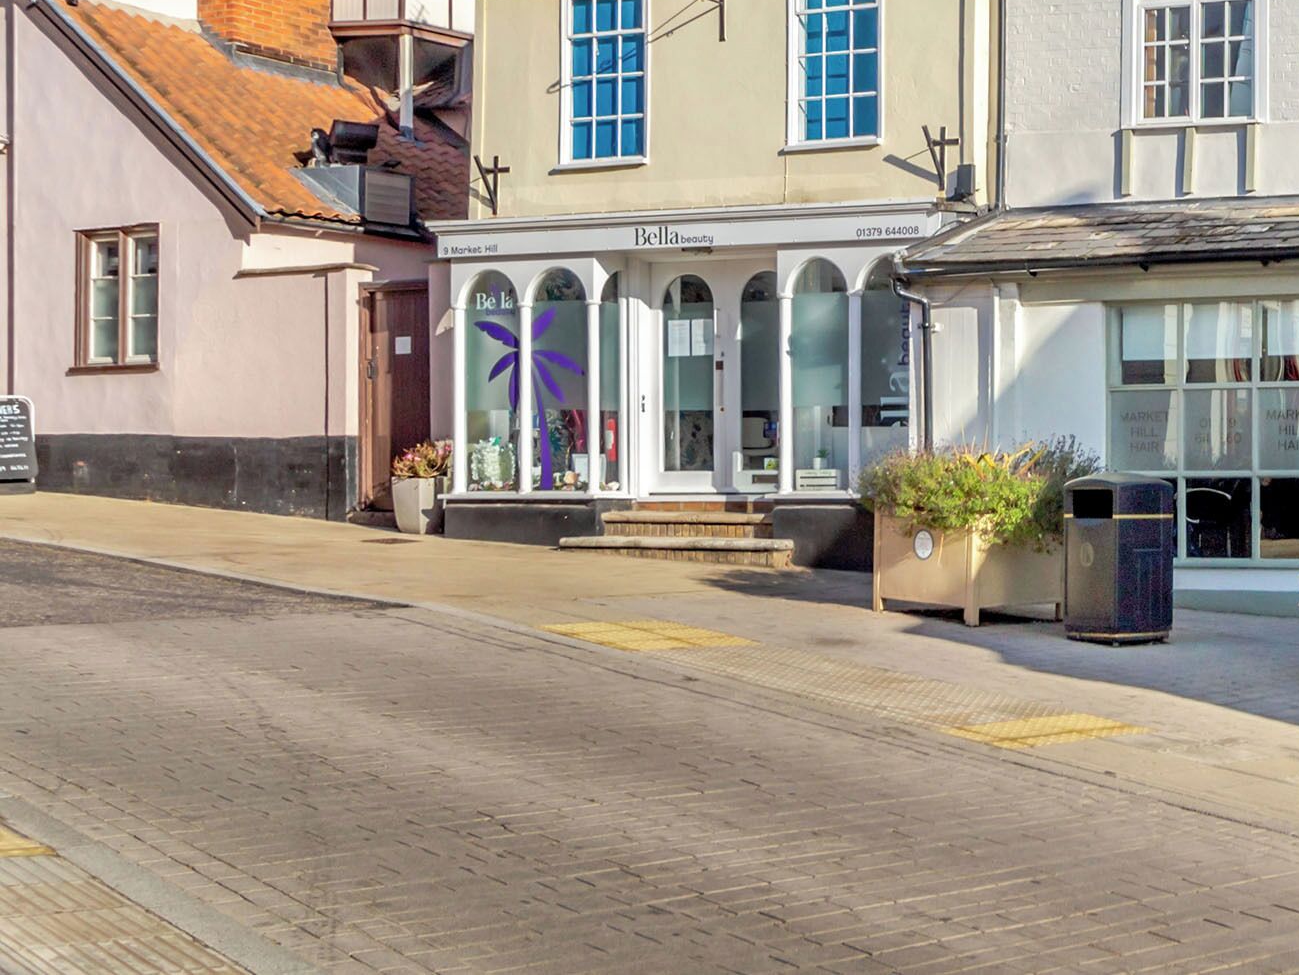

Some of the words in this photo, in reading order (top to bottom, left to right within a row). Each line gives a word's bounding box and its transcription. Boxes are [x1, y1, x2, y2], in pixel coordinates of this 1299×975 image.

[634, 226, 680, 246] Bella
[681, 235, 714, 245] beauty
[856, 227, 882, 237] 01379
[885, 226, 919, 236] 644008
[443, 246, 449, 256] 9
[451, 245, 482, 255] Market
[485, 243, 498, 254] Hill
[476, 291, 514, 310] Bela
